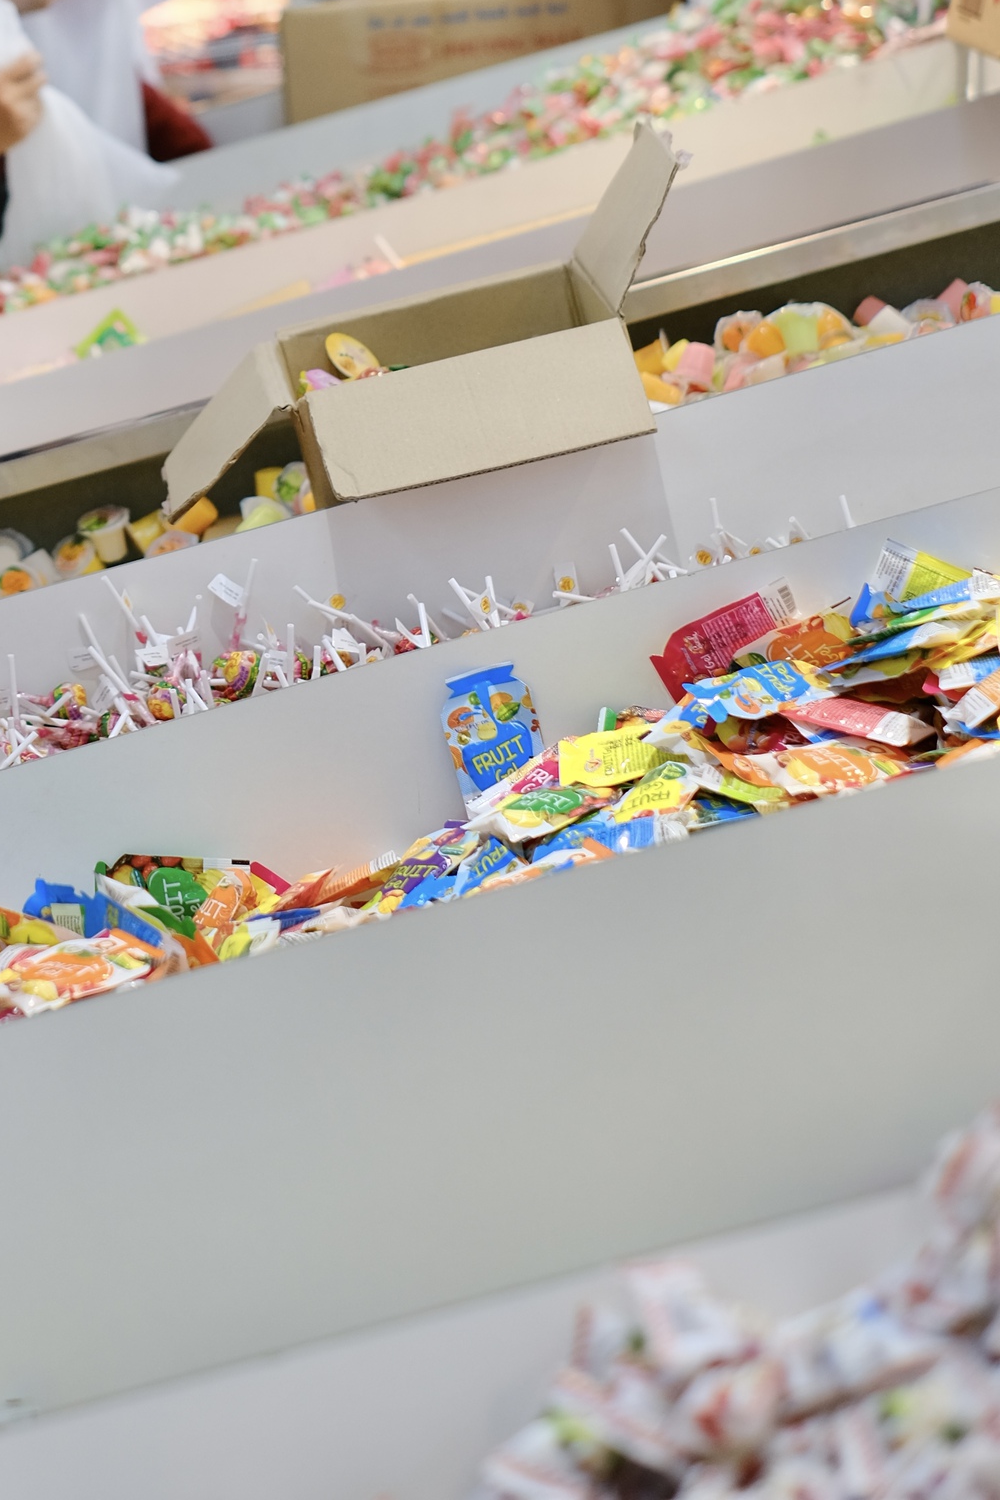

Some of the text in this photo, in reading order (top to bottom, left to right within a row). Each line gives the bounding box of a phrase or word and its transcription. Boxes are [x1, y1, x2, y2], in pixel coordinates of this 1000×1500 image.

[472, 734, 525, 775] FRUIT
[392, 864, 438, 879] FRUIT
[384, 876, 409, 890] Gel
